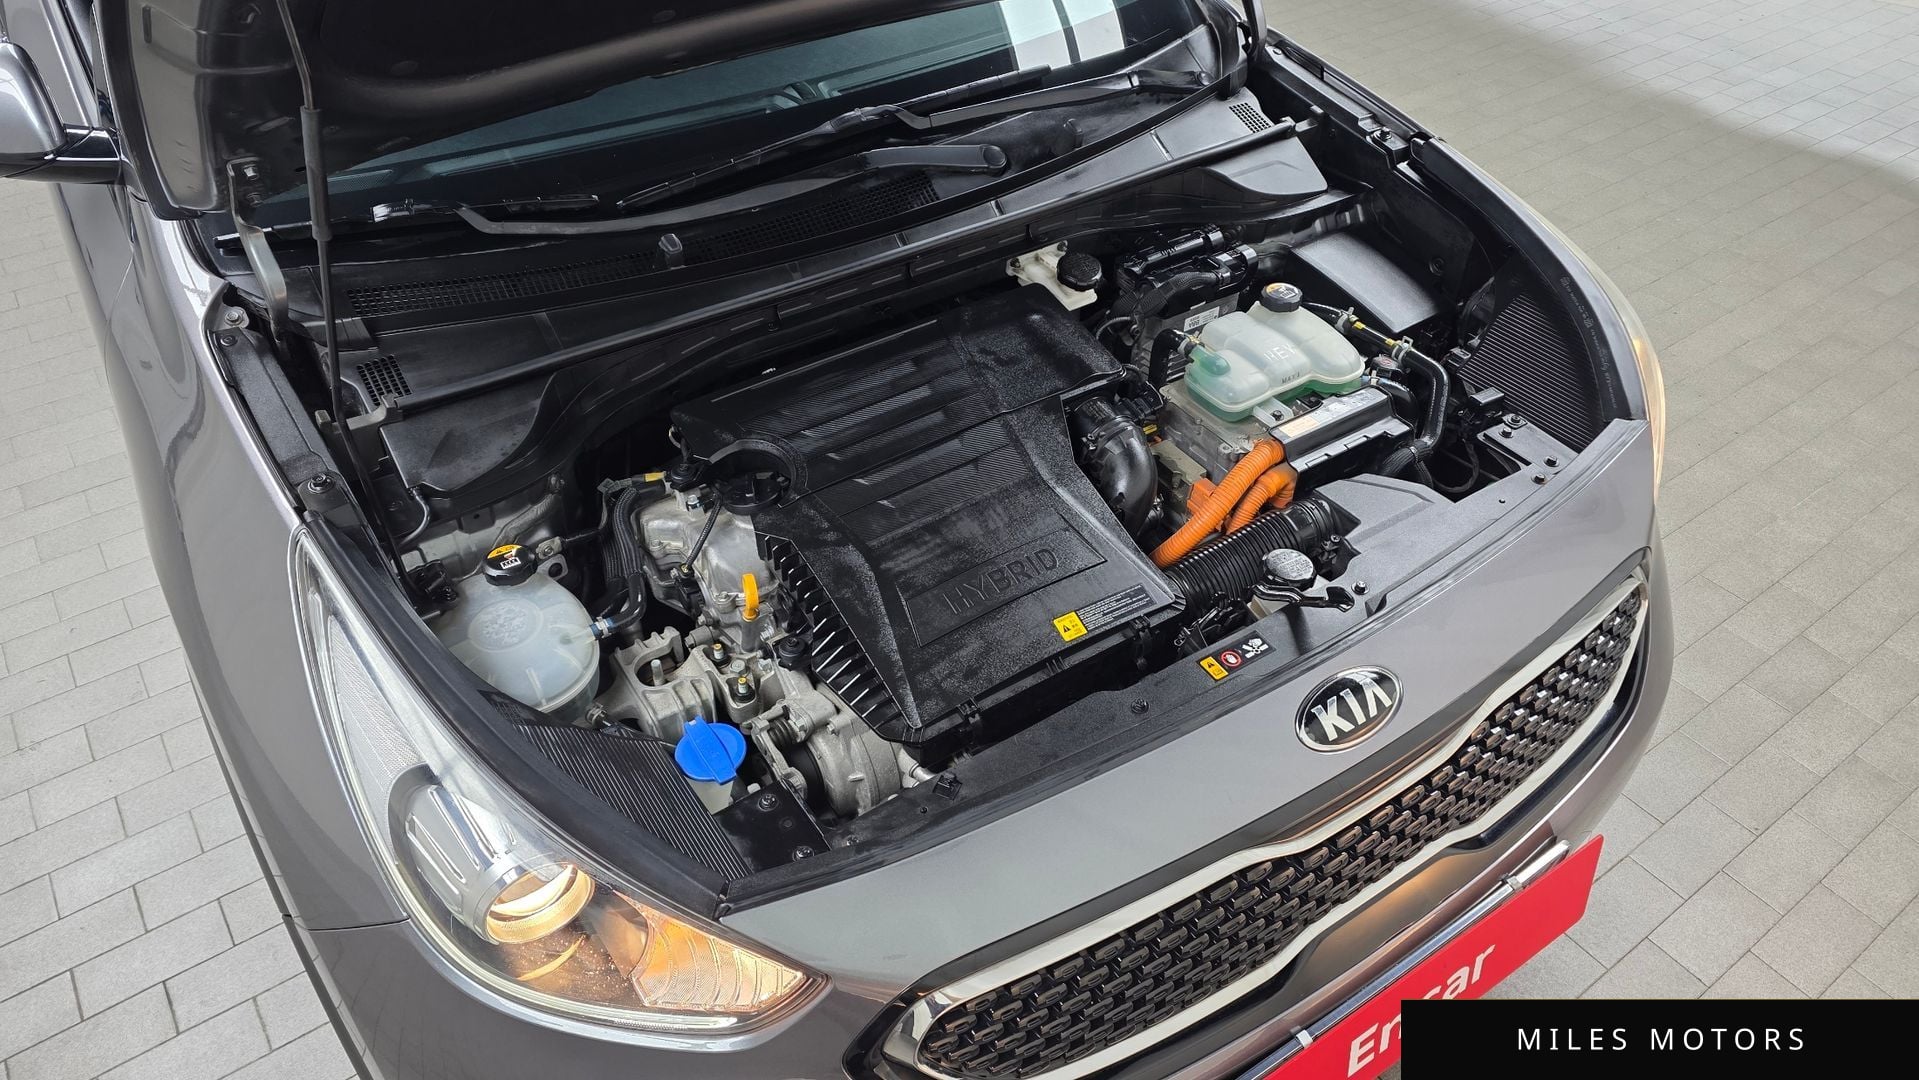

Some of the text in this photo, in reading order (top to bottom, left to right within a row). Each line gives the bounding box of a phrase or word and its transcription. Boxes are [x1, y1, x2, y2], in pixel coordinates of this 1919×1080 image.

[943, 549, 1059, 614] HYBRID
[1310, 677, 1393, 742] KIA
[1347, 944, 1496, 1078] Enar
